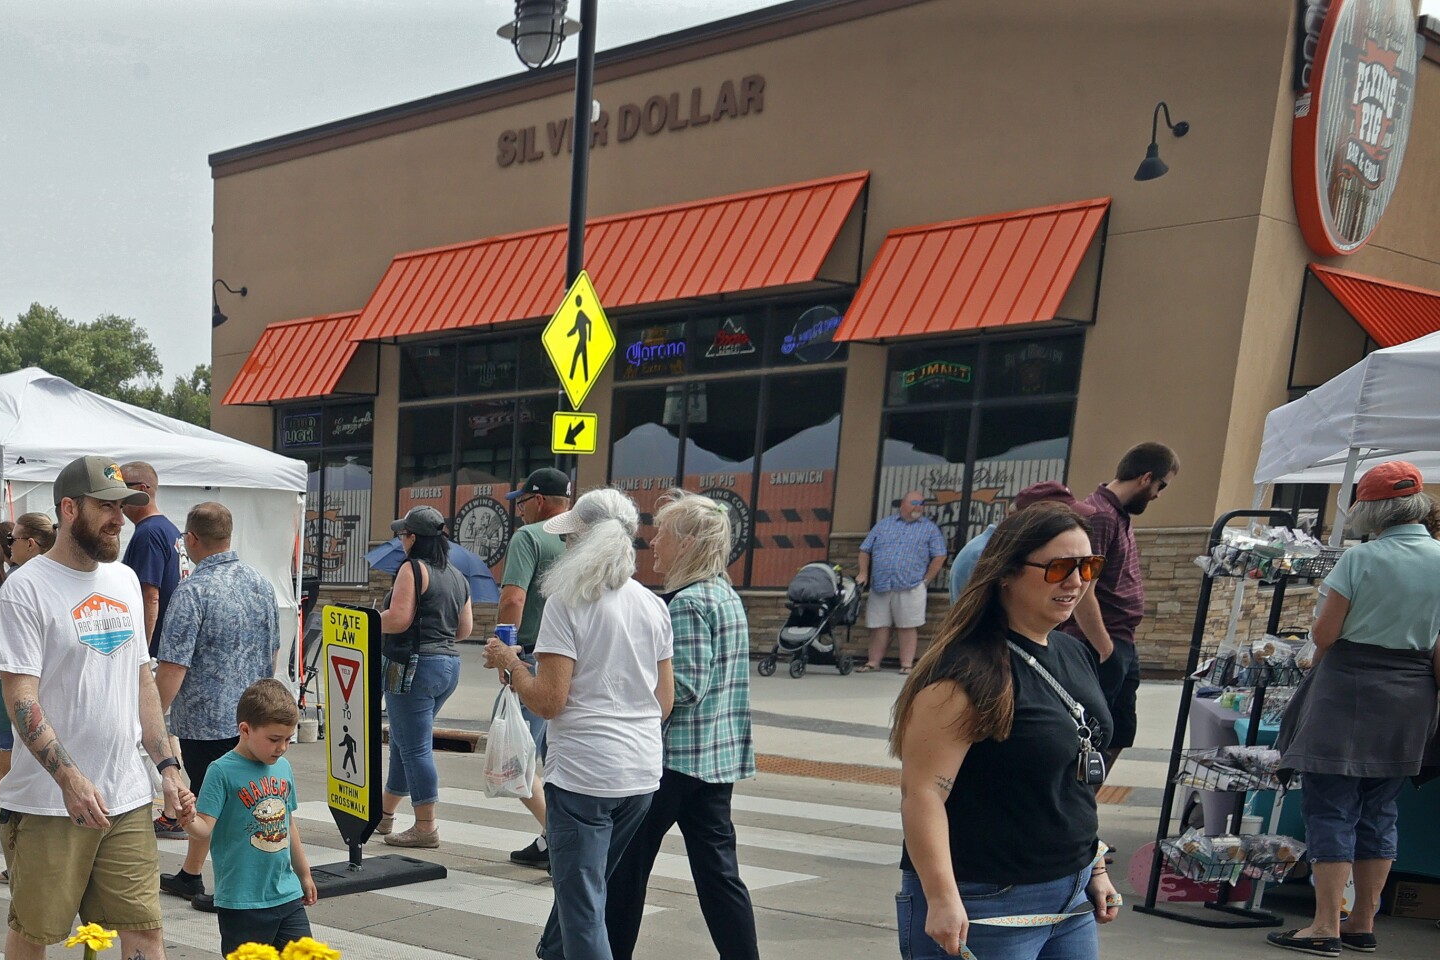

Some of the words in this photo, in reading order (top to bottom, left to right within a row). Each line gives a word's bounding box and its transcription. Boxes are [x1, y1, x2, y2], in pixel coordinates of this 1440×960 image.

[1353, 62, 1398, 119] FLYING
[616, 74, 766, 143] DOLLAR
[1359, 102, 1384, 145] PIG
[1347, 141, 1359, 165] BAR
[626, 341, 686, 367] Corona
[284, 429, 315, 443] LIGH
[642, 477, 654, 490] OF
[656, 476, 675, 489] THE
[699, 475, 716, 488] BIG
[719, 474, 736, 487] PIG
[770, 471, 823, 485] SANDWICH
[410, 486, 443, 499] BURGERS
[473, 485, 493, 497] BEER
[461, 498, 494, 517] BREWING
[494, 504, 509, 546] COMPANY
[731, 497, 750, 544] COMPANY
[330, 611, 361, 630] STATE
[335, 629, 356, 645] LAW
[342, 708, 352, 721] TO
[338, 783, 359, 799] WITHIN
[330, 793, 366, 815] CROSSWALK
